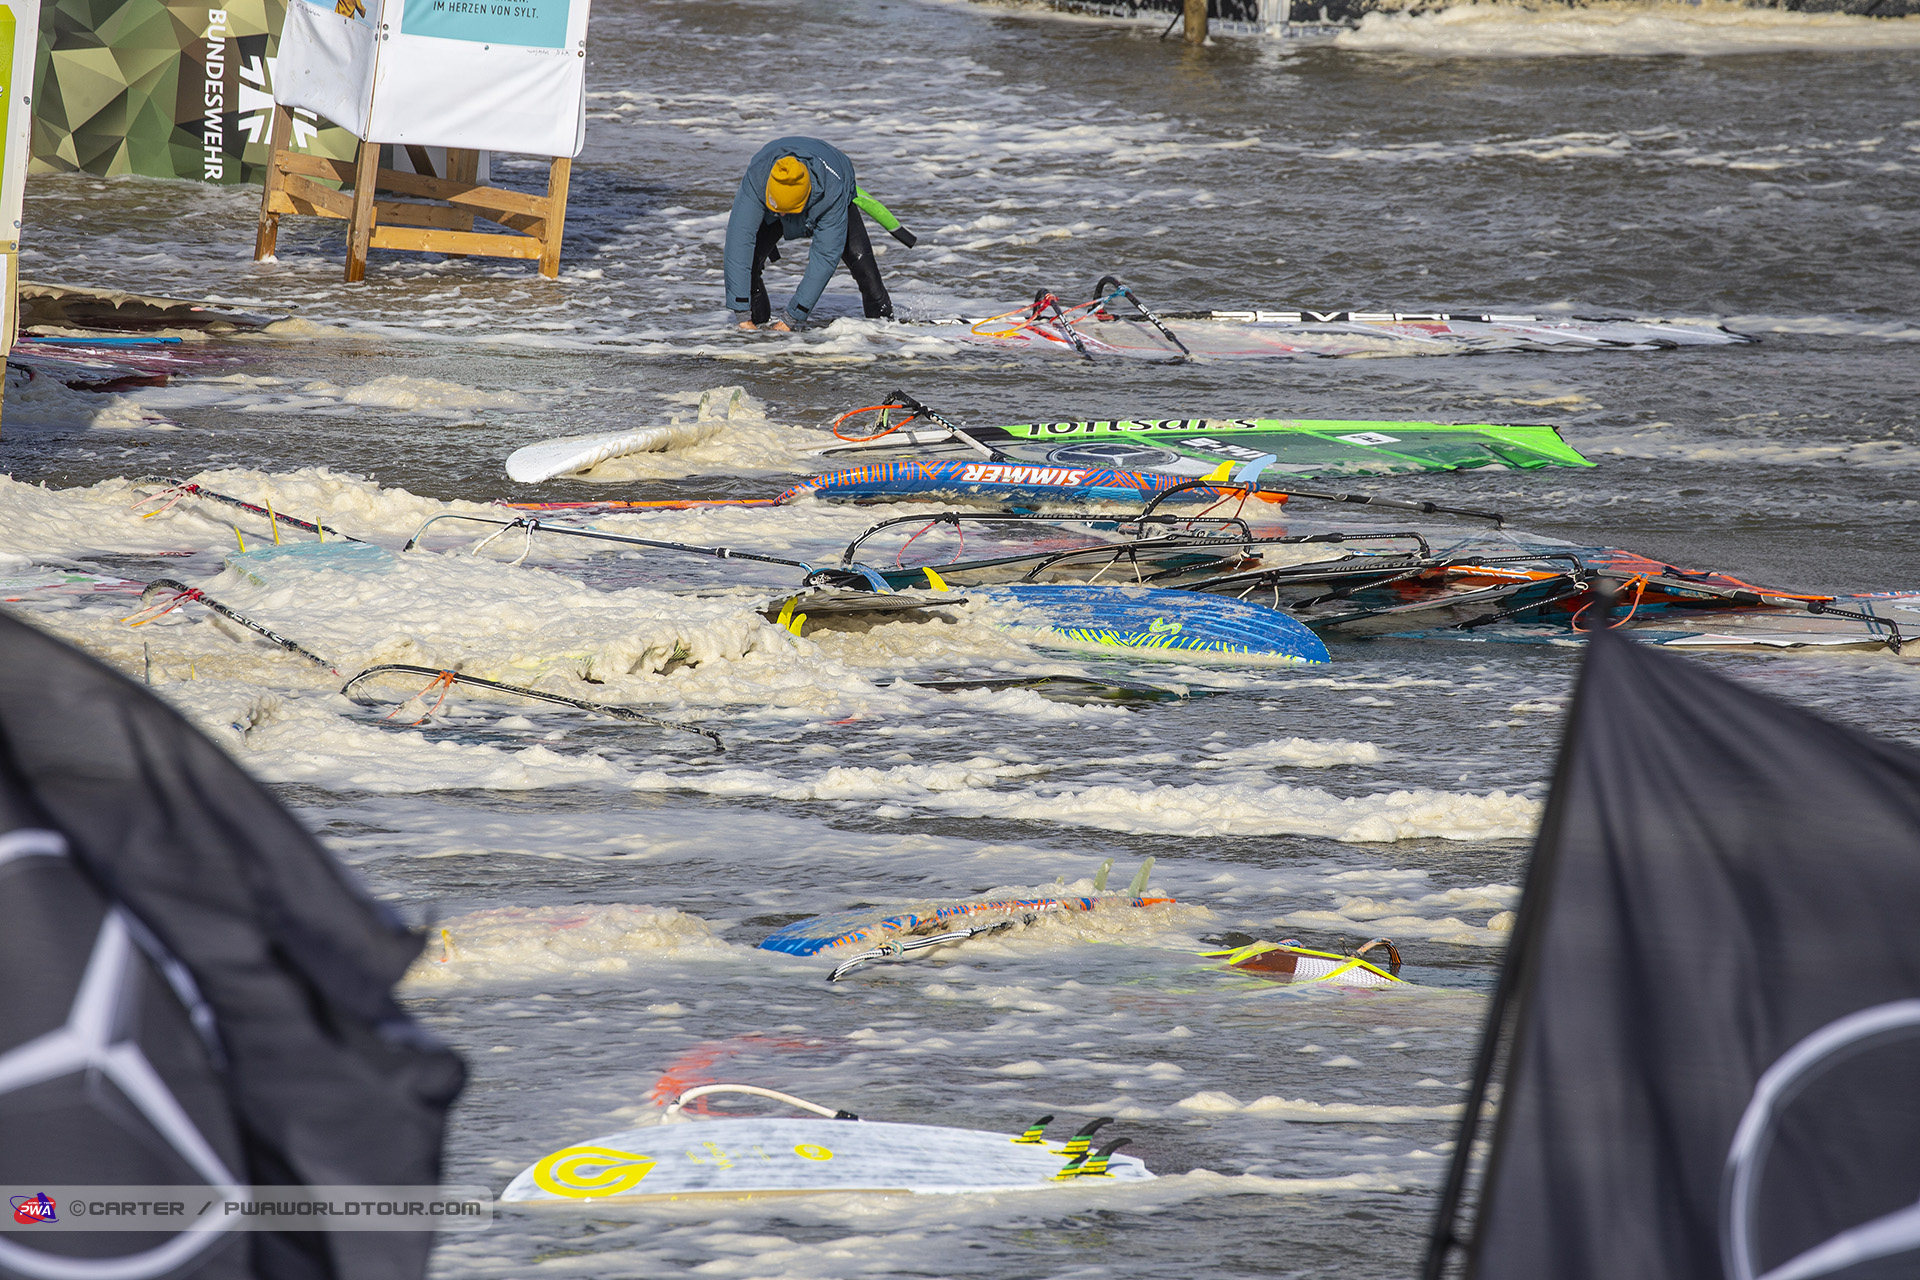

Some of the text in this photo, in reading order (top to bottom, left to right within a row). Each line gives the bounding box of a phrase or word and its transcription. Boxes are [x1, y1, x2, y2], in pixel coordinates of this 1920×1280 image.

[432, 1, 539, 19] IM HERZEN VON SYLT.
[203, 8, 227, 180] BUNDESWEHR
[962, 464, 1087, 487] SIMMER
